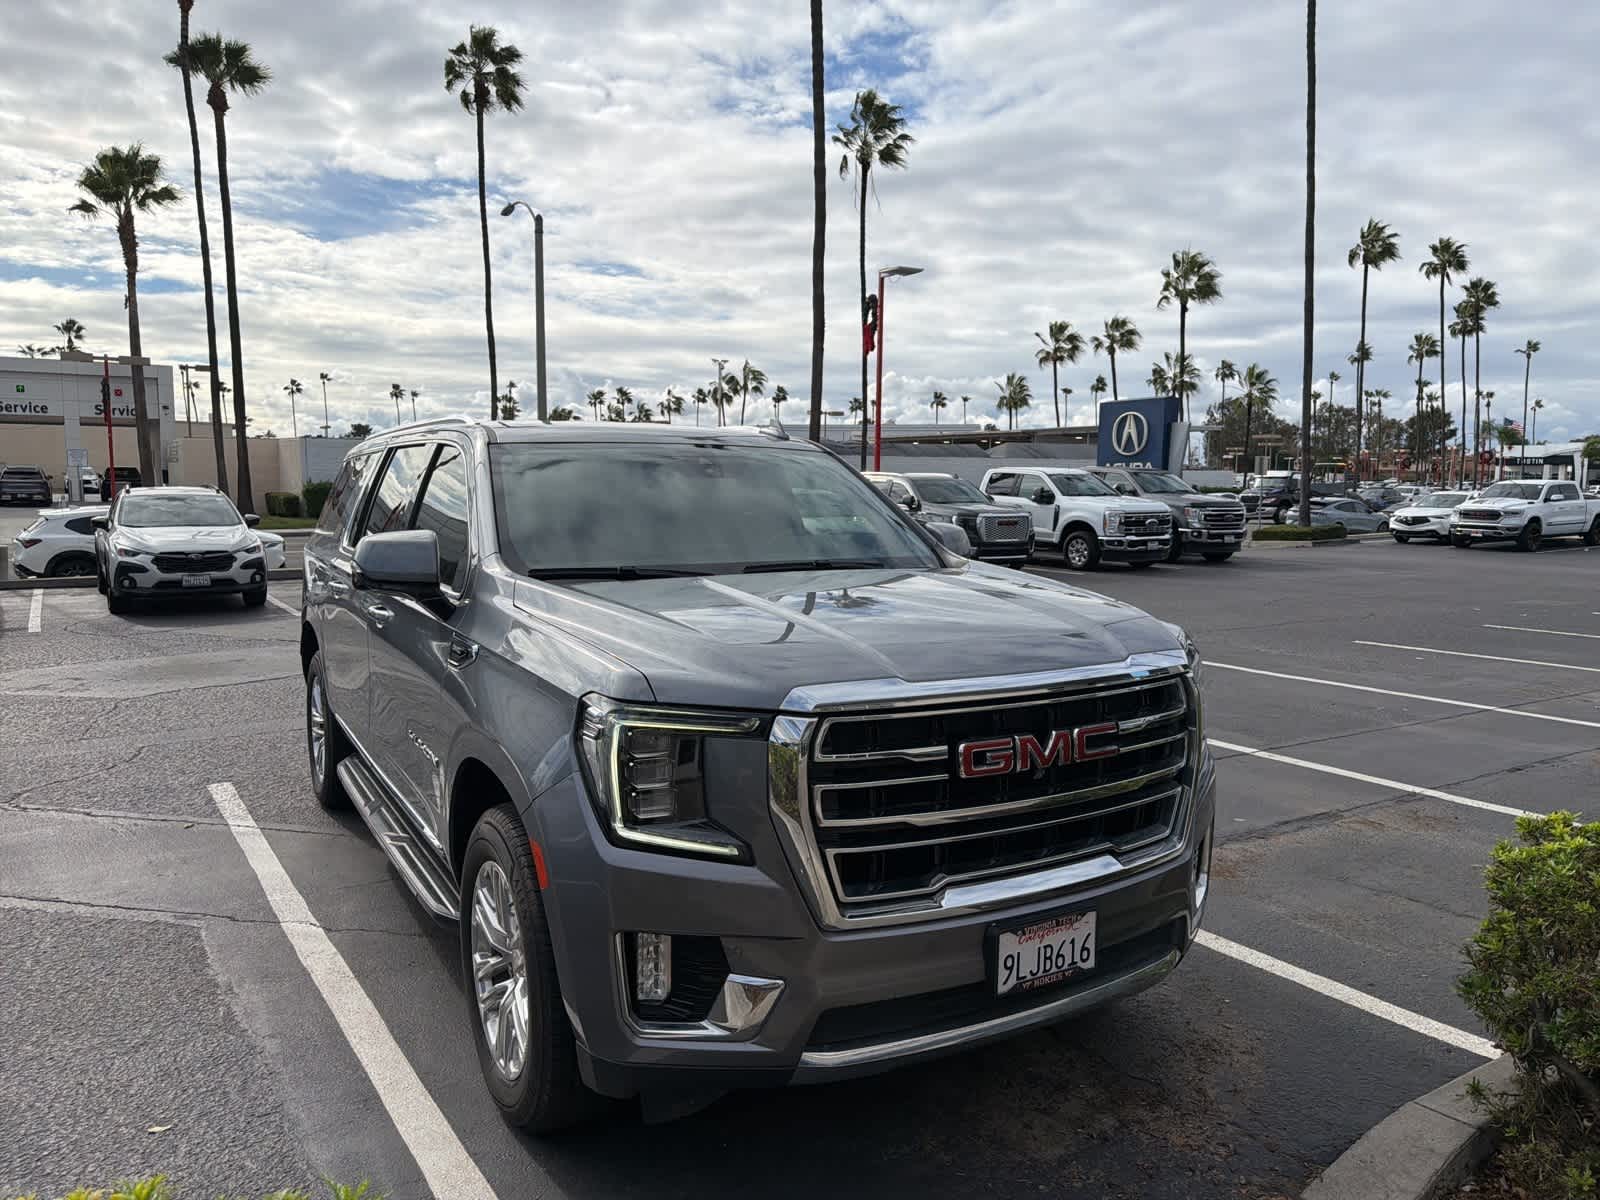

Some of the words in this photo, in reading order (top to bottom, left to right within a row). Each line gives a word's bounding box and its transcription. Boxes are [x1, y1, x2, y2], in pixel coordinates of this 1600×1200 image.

[94, 404, 136, 417] Srvic
[959, 722, 1120, 778] GMC
[1003, 932, 1092, 986] 9LJB616
